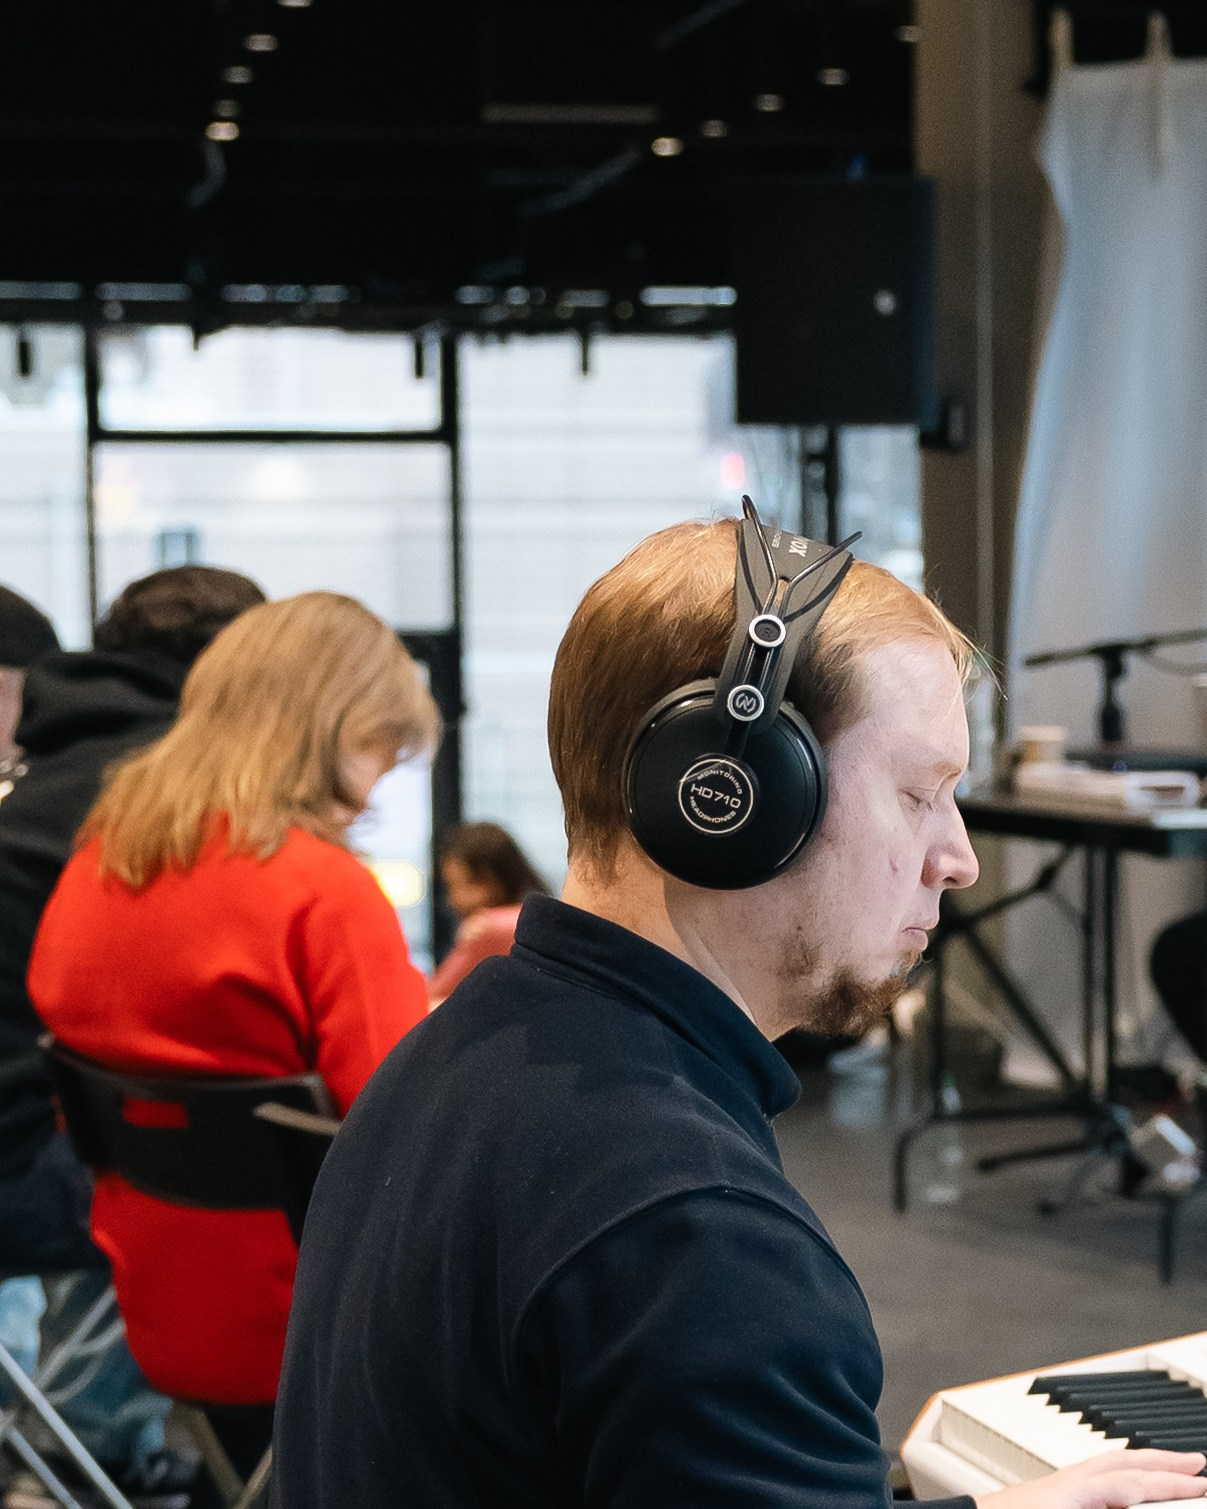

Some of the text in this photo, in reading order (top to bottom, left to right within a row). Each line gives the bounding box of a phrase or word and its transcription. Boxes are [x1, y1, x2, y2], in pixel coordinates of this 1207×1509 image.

[697, 769, 743, 794] MONITORING
[690, 783, 741, 809] HD710
[689, 796, 737, 823] HEADPHONES
